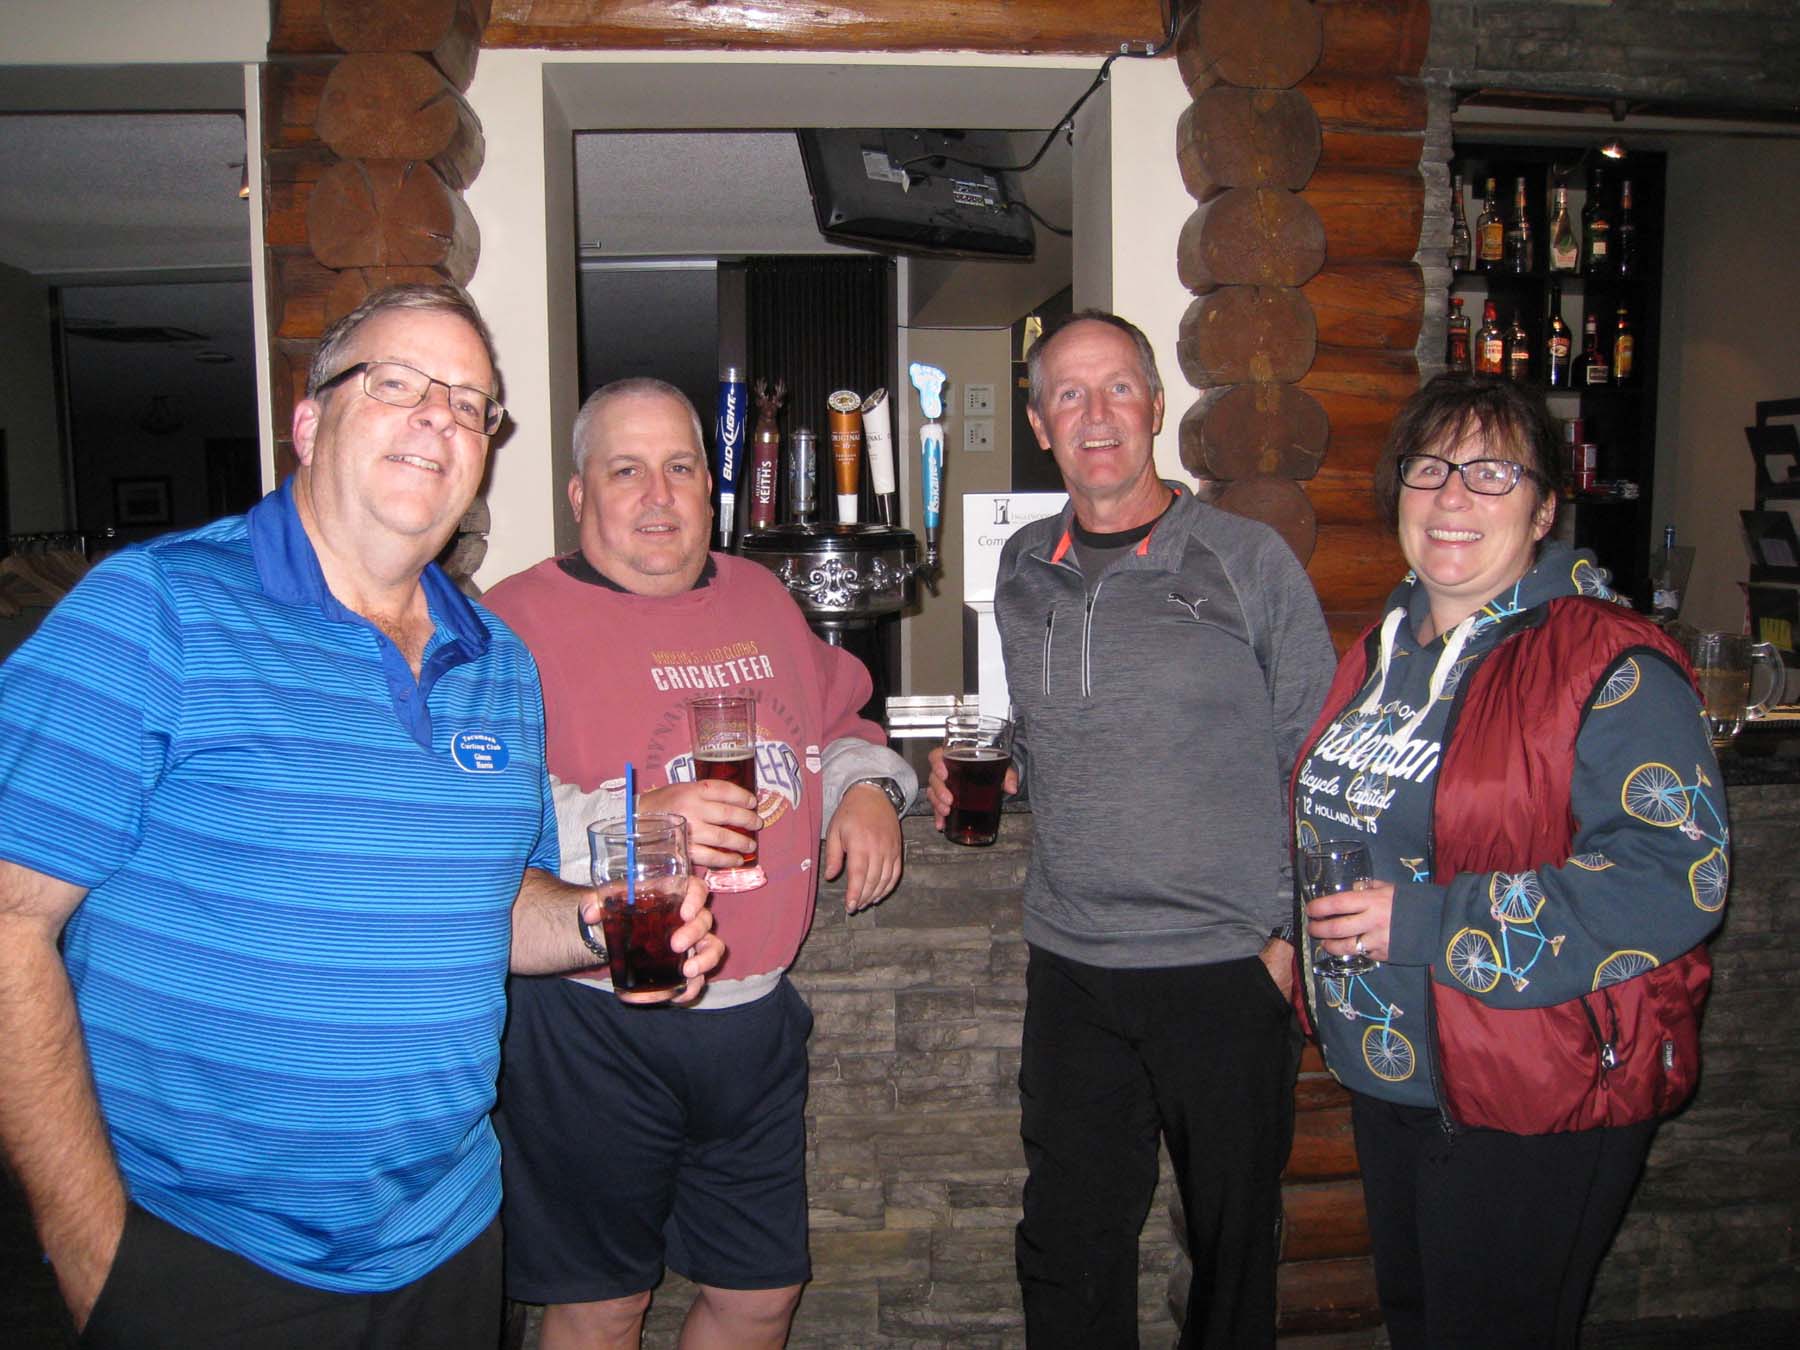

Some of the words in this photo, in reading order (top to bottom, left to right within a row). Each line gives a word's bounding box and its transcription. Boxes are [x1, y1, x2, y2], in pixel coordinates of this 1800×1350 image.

[724, 393, 737, 441] LIGHT
[722, 446, 734, 482] BUD
[977, 535, 1008, 547] Com
[650, 654, 775, 692] CRICKETEER
[1303, 795, 1312, 815] 12
[1345, 776, 1396, 810] Capital
